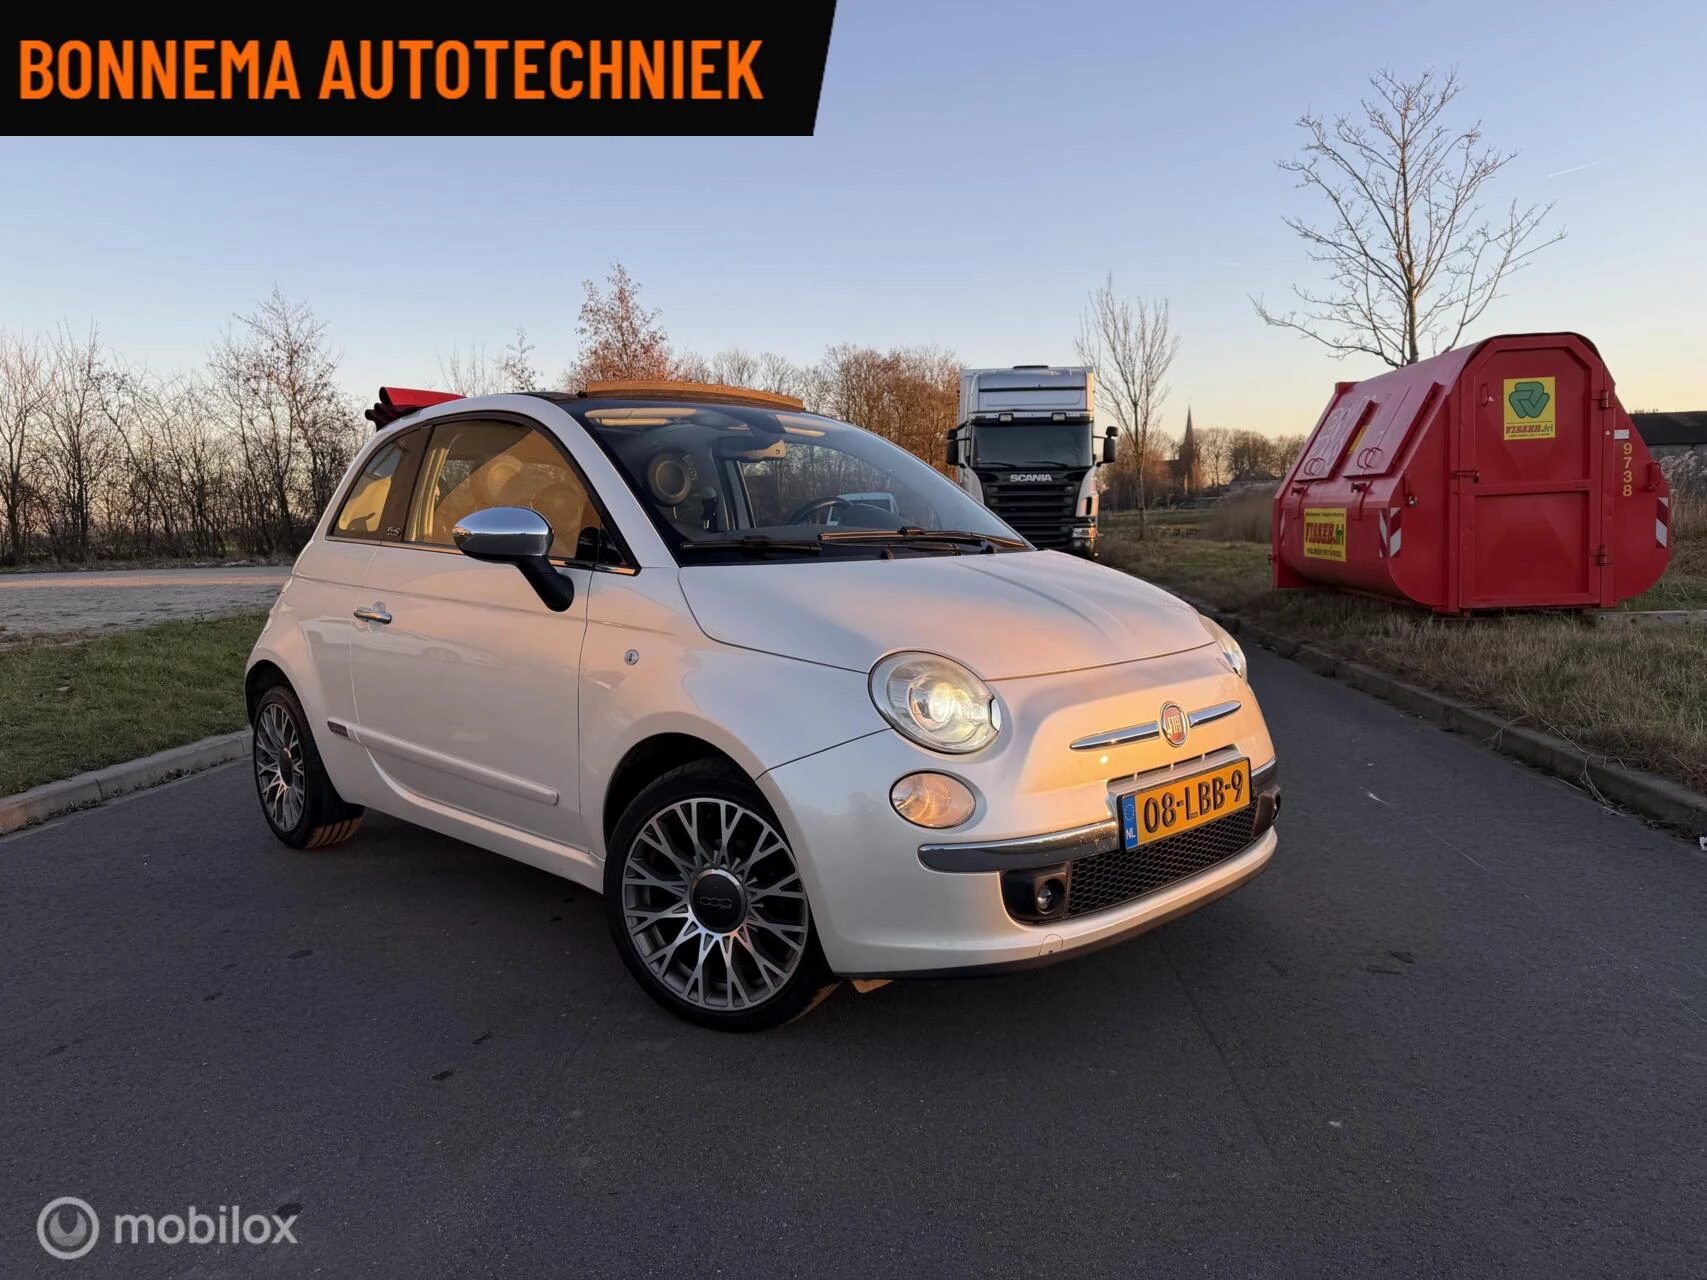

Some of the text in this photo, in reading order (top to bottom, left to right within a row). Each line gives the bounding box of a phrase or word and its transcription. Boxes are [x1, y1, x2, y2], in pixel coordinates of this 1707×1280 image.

[1010, 474, 1053, 482] SCANIA
[1623, 443, 1632, 496] 9738
[1143, 769, 1243, 834] 08-LBB-9
[1125, 828, 1136, 840] NL
